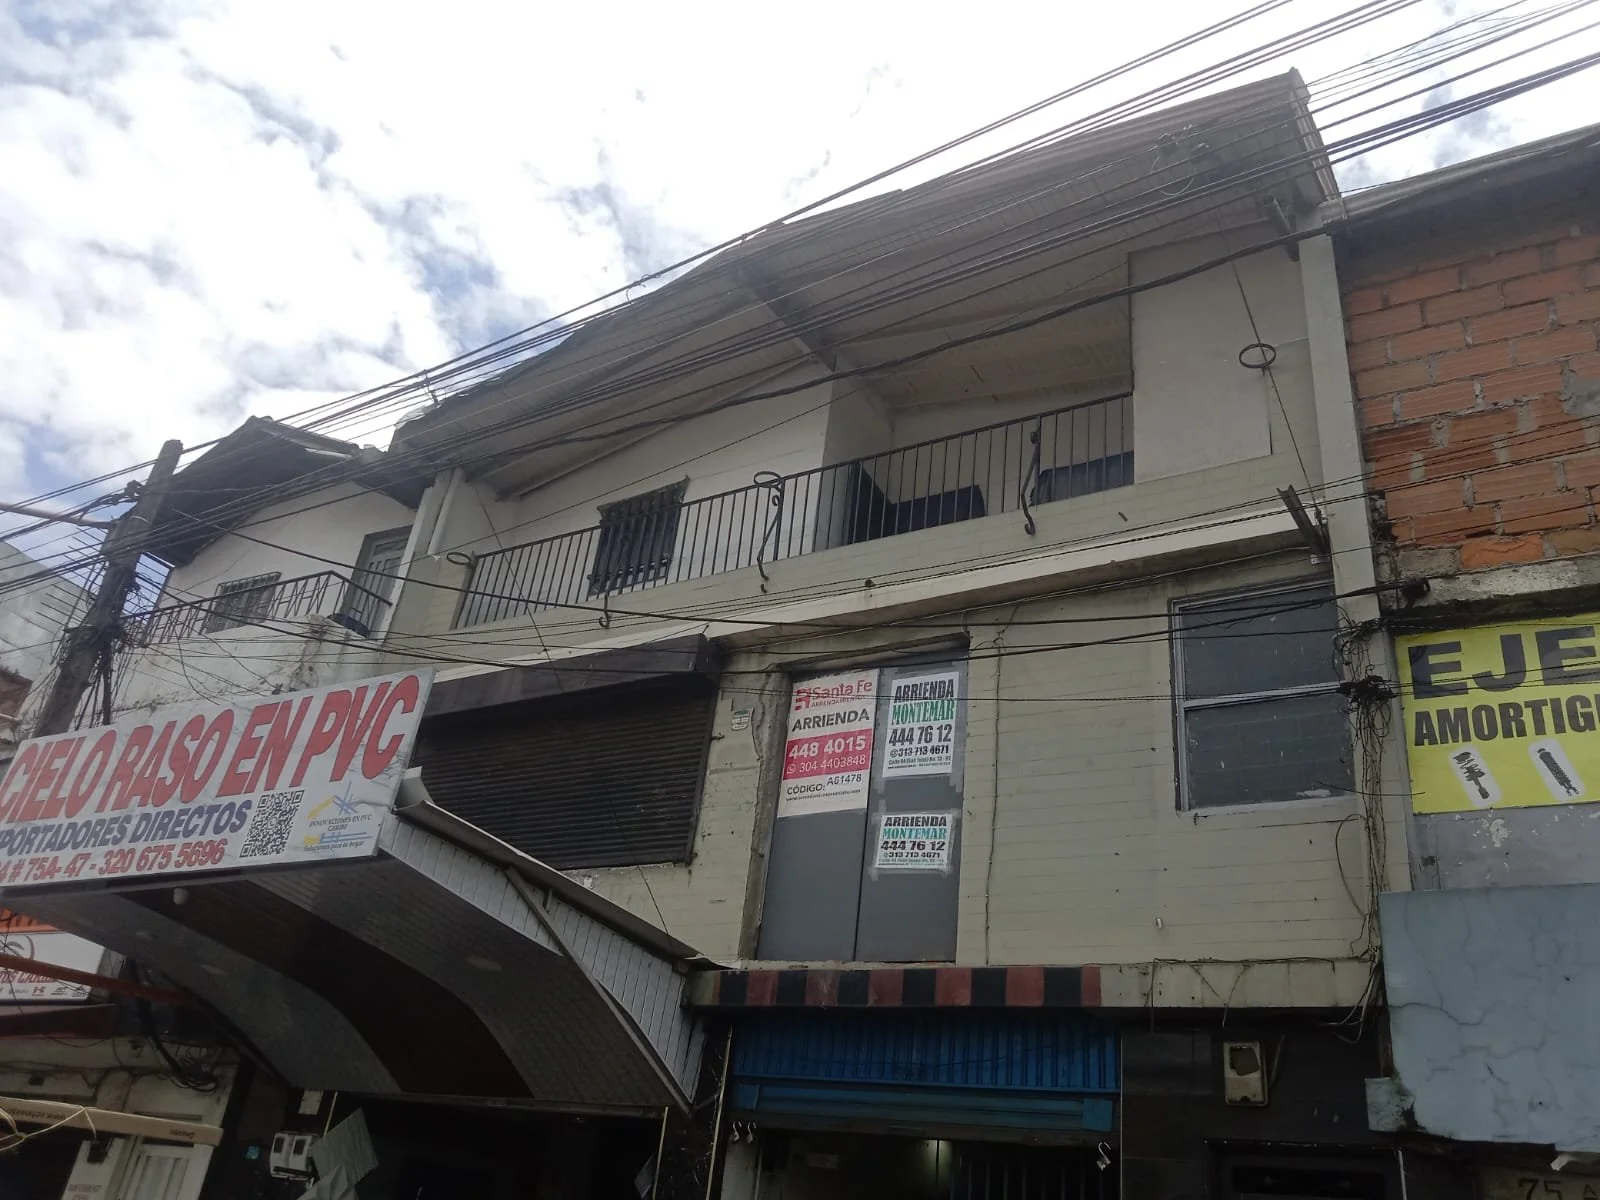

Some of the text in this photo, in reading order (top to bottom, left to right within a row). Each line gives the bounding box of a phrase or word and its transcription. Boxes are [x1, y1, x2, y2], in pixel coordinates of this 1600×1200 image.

[811, 680, 872, 698] Santa Fe
[894, 679, 954, 704] ARRIENDA
[791, 708, 870, 732] ARRIENDA
[891, 699, 955, 726] MONTEMAR
[889, 724, 953, 746] 444 76 12
[0, 675, 420, 823] CIELO RASO EN PVC
[789, 735, 866, 760] 448 4015
[914, 745, 928, 755] 713
[799, 754, 866, 773] 304 4403848
[787, 783, 826, 796] CÓDIGO:
[128, 800, 252, 843] DIRECTOS
[884, 816, 947, 827] ARRIENDA
[883, 828, 947, 839] MONTEMAR
[98, 847, 136, 875] 320
[136, 844, 176, 872] 675
[174, 838, 229, 868] 5696
[881, 841, 945, 851] 444 76 12
